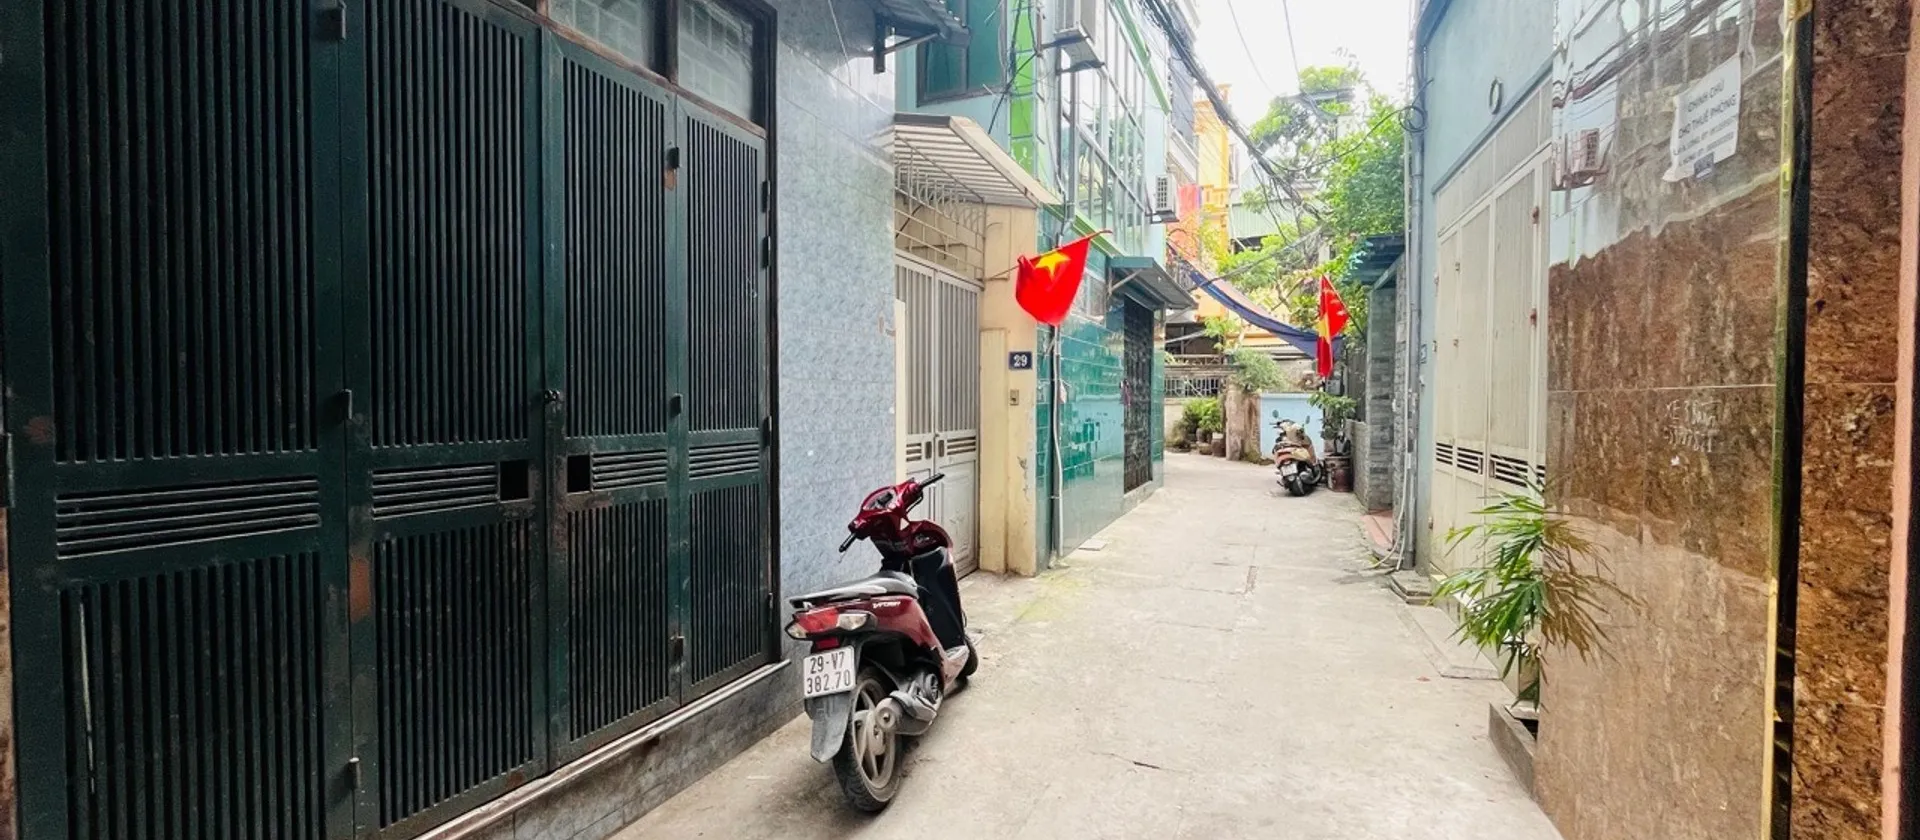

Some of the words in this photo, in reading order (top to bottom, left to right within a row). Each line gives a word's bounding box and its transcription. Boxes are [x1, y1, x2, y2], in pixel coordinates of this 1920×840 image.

[1013, 354, 1028, 367] 29
[810, 651, 846, 675] 29-V7
[806, 670, 851, 695] 382.70
